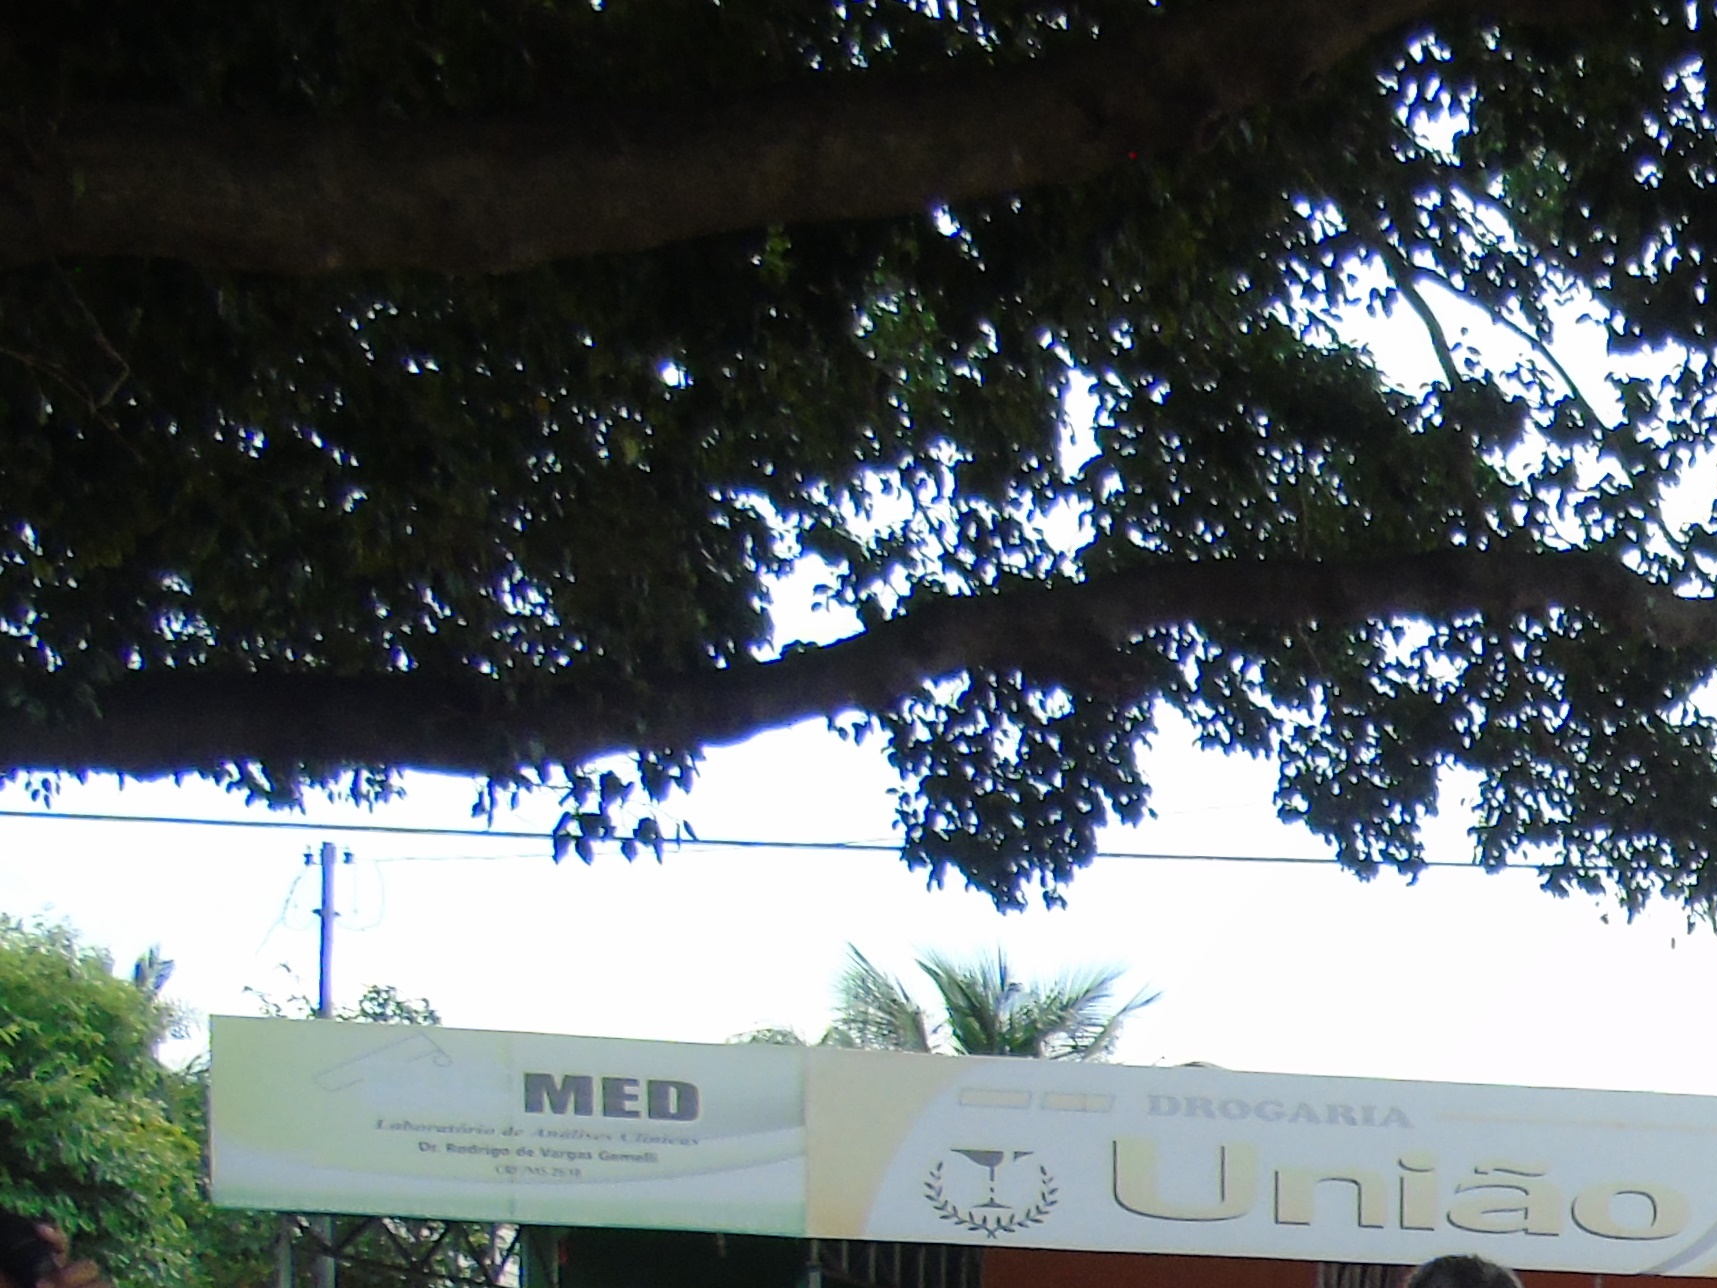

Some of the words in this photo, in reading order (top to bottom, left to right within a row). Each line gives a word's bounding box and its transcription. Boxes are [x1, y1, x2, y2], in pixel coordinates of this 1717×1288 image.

[523, 1072, 700, 1121] MED
[1146, 1092, 1416, 1130] DROGARIA
[446, 1142, 511, 1158] Rodrigo
[515, 1146, 536, 1157] de
[540, 1146, 593, 1161] Vargas
[1111, 1134, 1694, 1241] União
